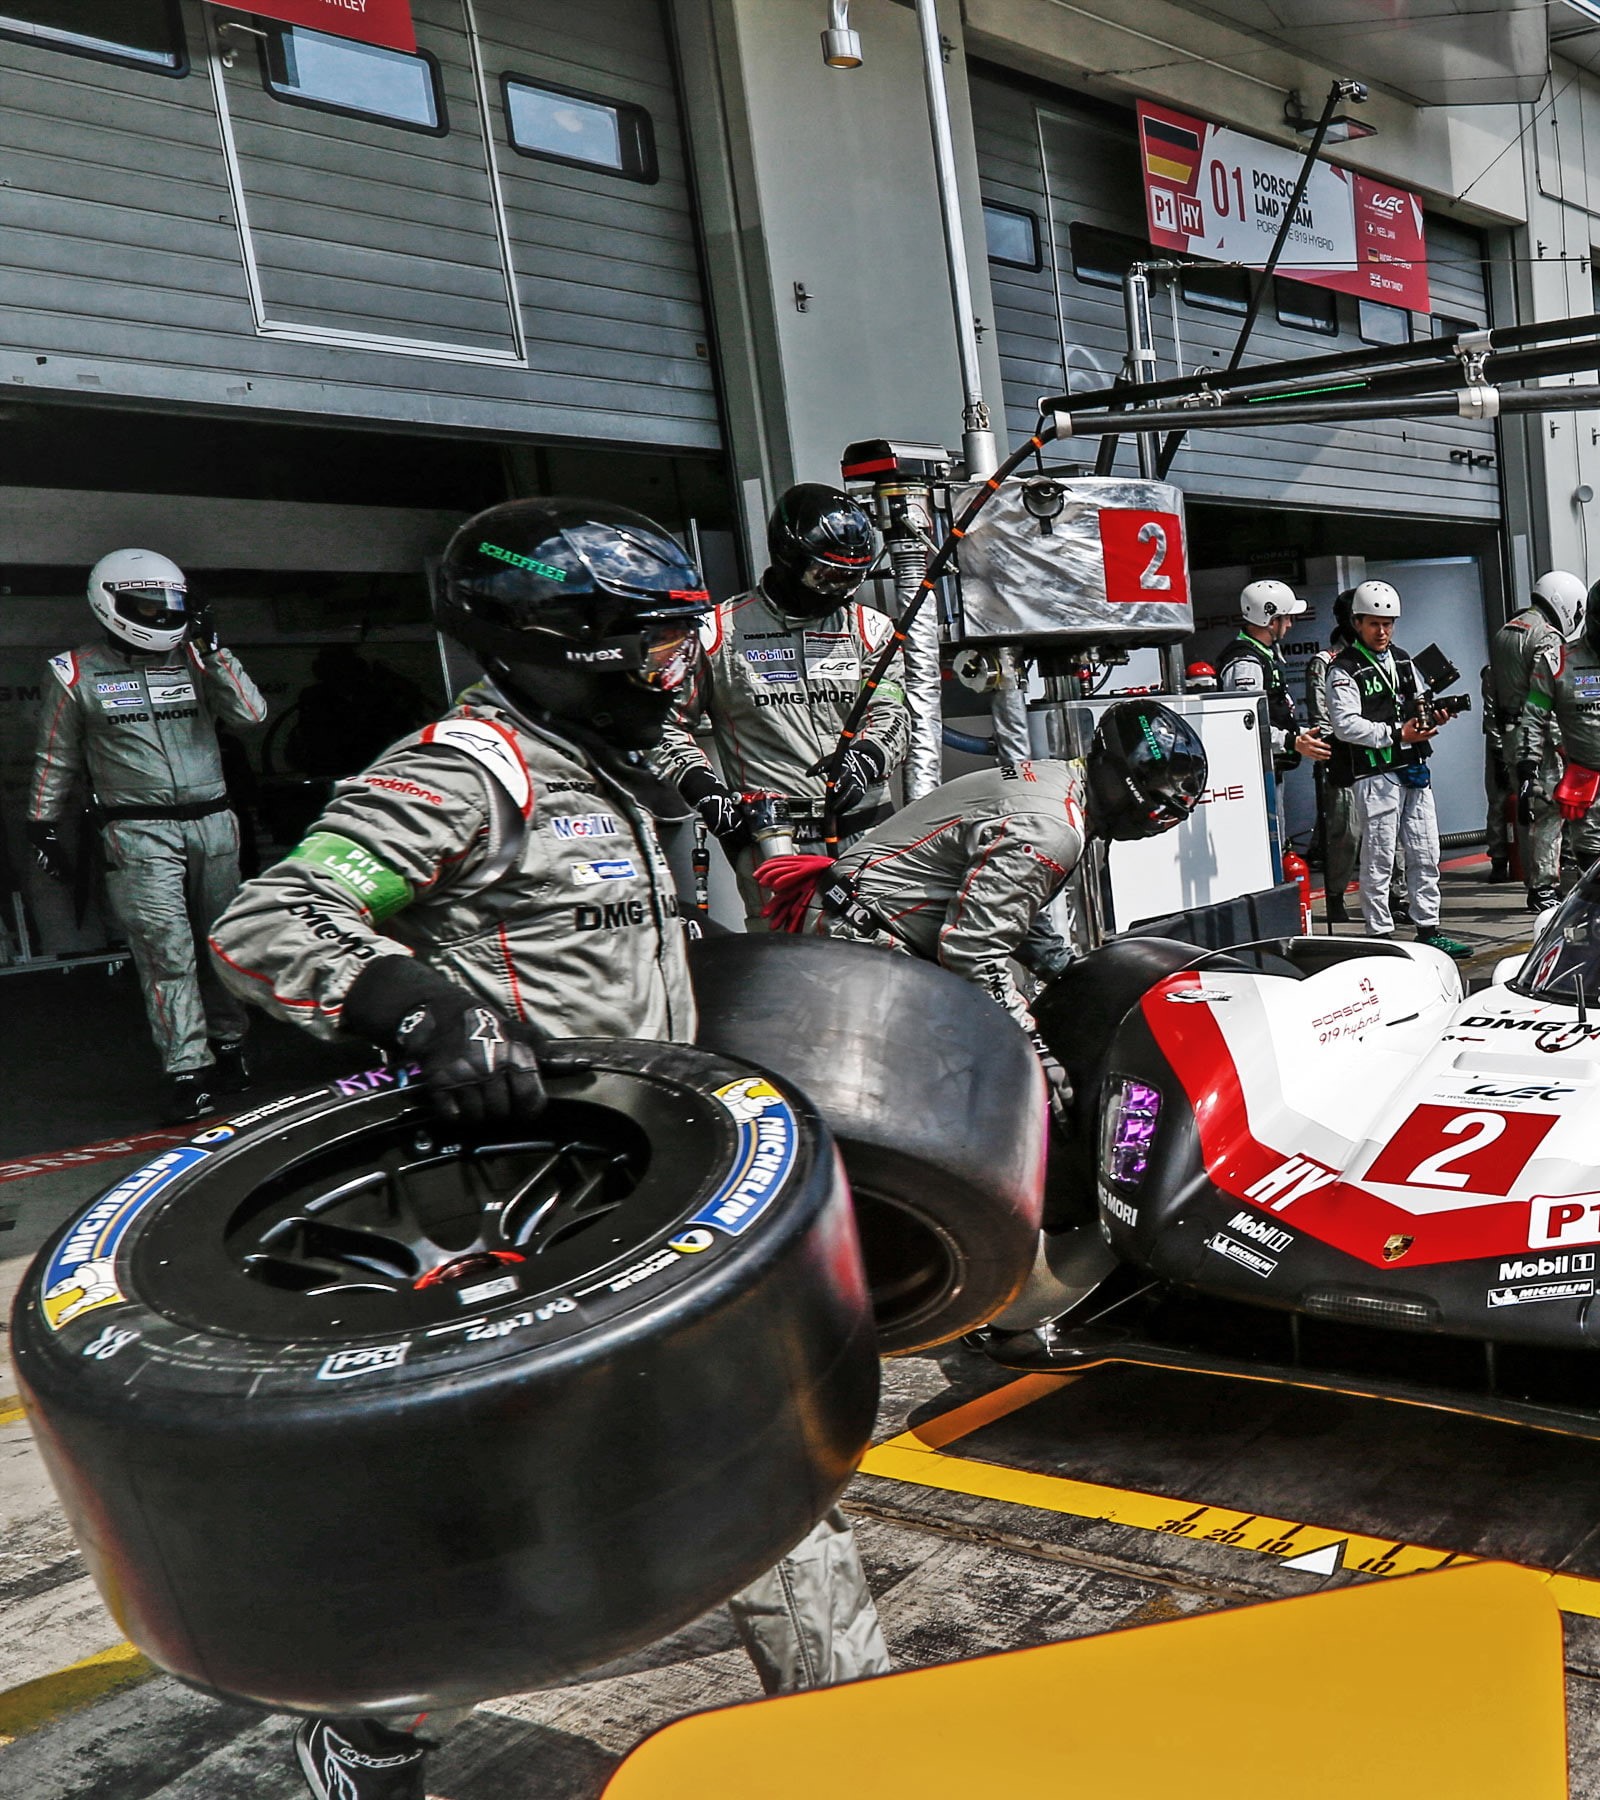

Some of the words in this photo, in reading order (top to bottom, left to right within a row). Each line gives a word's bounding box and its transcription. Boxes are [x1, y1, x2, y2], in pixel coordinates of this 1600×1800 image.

[1210, 159, 1247, 222] 01
[1252, 169, 1309, 205] PORSCE
[1371, 193, 1405, 214] WEC
[1155, 198, 1174, 225] P1
[1180, 202, 1201, 231] HY
[1254, 193, 1279, 218] LMP
[1281, 201, 1314, 229] TAM
[1256, 219, 1294, 240] PORSE
[1308, 234, 1335, 252] HYBRID
[478, 541, 567, 582] SCHAEFFLER
[1136, 522, 1172, 591] 2
[117, 581, 187, 592] PORSC
[567, 647, 623, 662] uvex
[747, 649, 782, 661] Mobil
[820, 662, 857, 671] WEC
[98, 683, 128, 693] Mobil
[754, 691, 804, 708] DMG
[107, 713, 149, 725] DMG
[154, 710, 199, 721] MORI
[364, 777, 444, 806] vodafone
[323, 855, 378, 895] LANE
[346, 849, 384, 874] PIT
[576, 902, 643, 931] DMG
[1311, 994, 1380, 1029] PORSCHE
[1318, 1026, 1341, 1046] 919
[1343, 1008, 1381, 1039] hybrid
[1459, 1016, 1565, 1032] DMG
[1464, 1084, 1575, 1101] WEC
[1405, 1110, 1506, 1188] 2
[716, 1117, 785, 1224] MICHELIN
[1243, 1156, 1339, 1212] HY
[60, 1152, 184, 1266] MICHELIN
[1107, 1191, 1138, 1227] MORI
[1227, 1211, 1271, 1245] Mobil
[1227, 1243, 1273, 1272] MICHELIN
[1499, 1255, 1569, 1281] Mobil
[1518, 1281, 1590, 1299] MICHELIN
[1156, 1519, 1198, 1535] 30
[1203, 1528, 1246, 1544] 20
[1256, 1538, 1295, 1554] 10
[1357, 1557, 1397, 1574] 10
